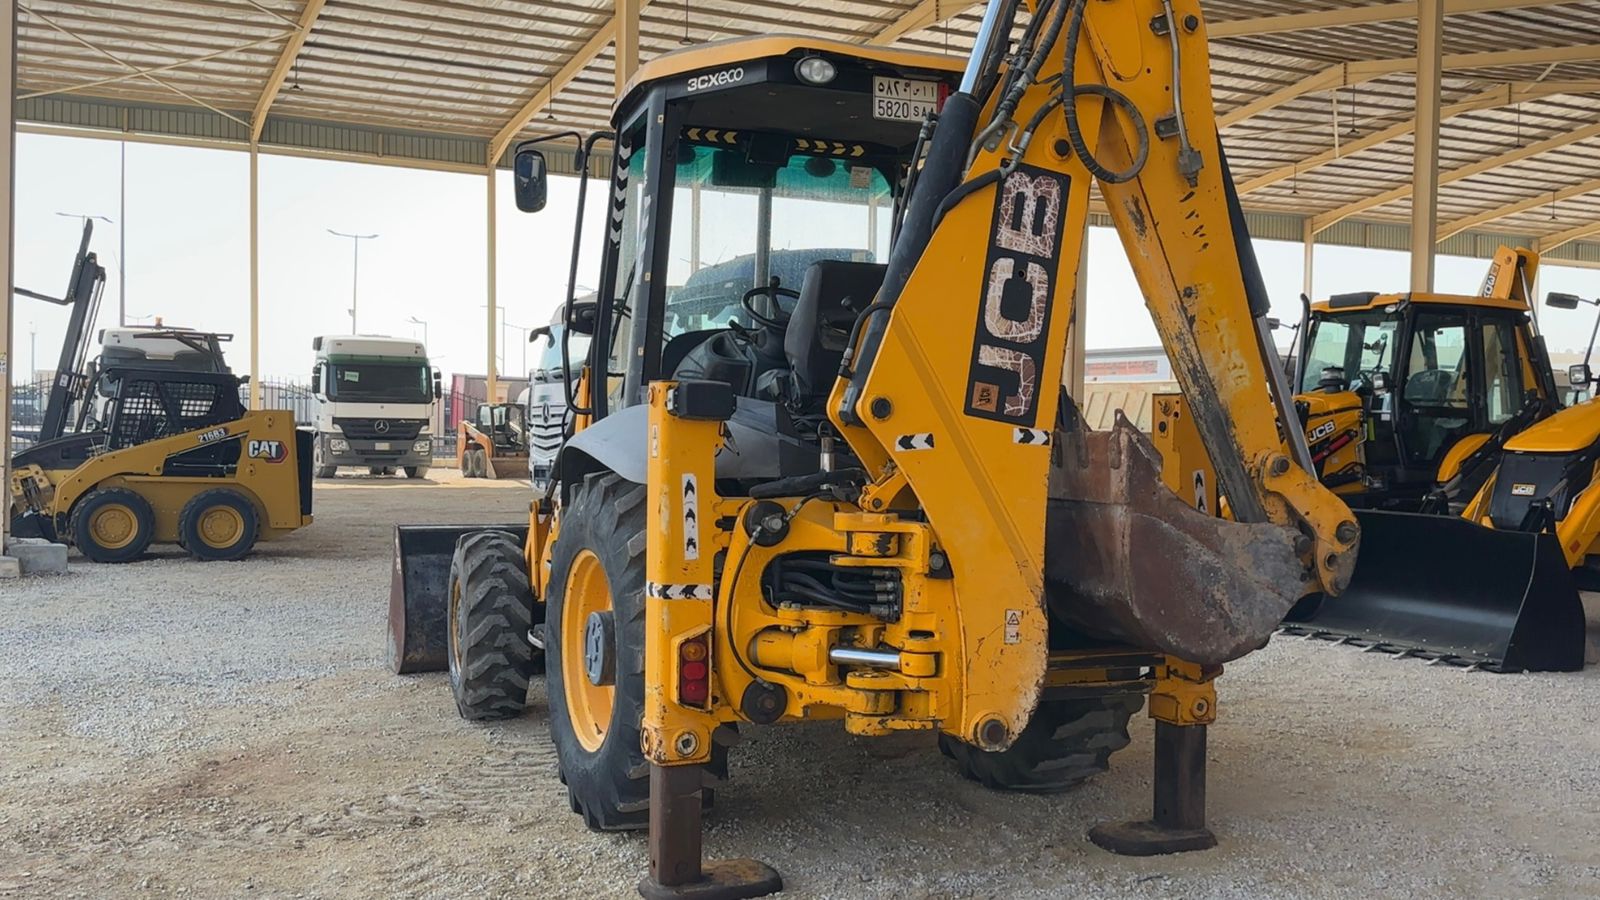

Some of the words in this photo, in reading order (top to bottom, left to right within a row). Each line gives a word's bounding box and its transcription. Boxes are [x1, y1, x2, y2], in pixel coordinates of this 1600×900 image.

[687, 67, 744, 92] 3CXeco
[878, 100, 910, 119] 5820
[978, 171, 1061, 417] JCB
[1309, 421, 1336, 442] JCB
[248, 440, 279, 458] CAT
